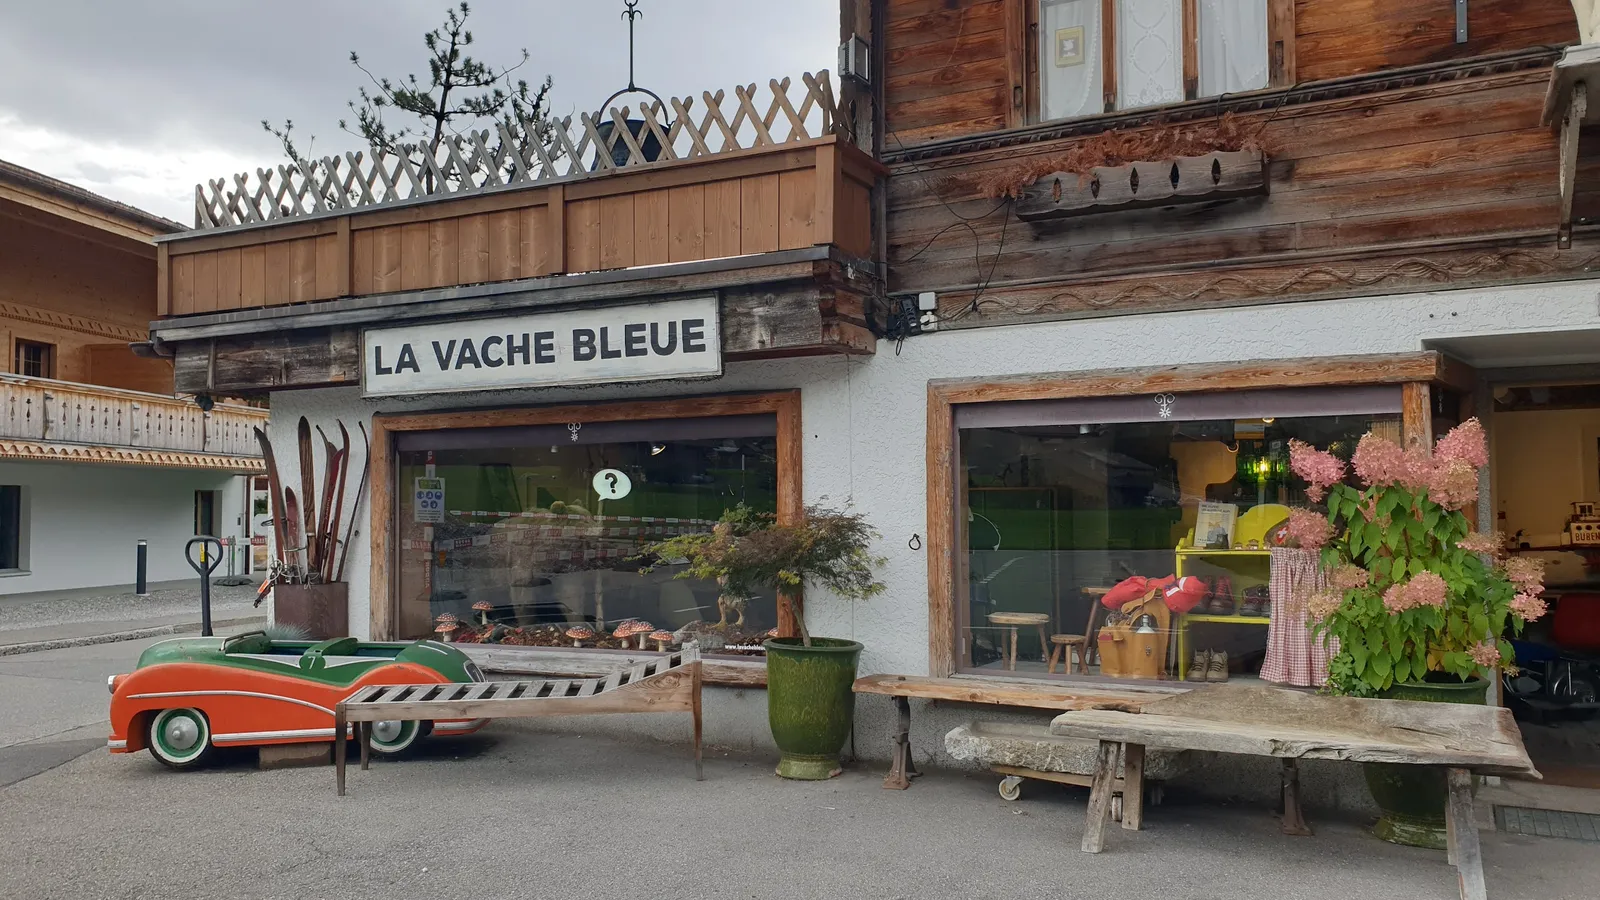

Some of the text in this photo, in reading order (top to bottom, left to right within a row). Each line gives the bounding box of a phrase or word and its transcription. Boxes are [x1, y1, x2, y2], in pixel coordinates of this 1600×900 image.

[374, 318, 707, 376] LA VACHE BLEUE
[604, 472, 618, 494] ?
[307, 655, 316, 670] 7
